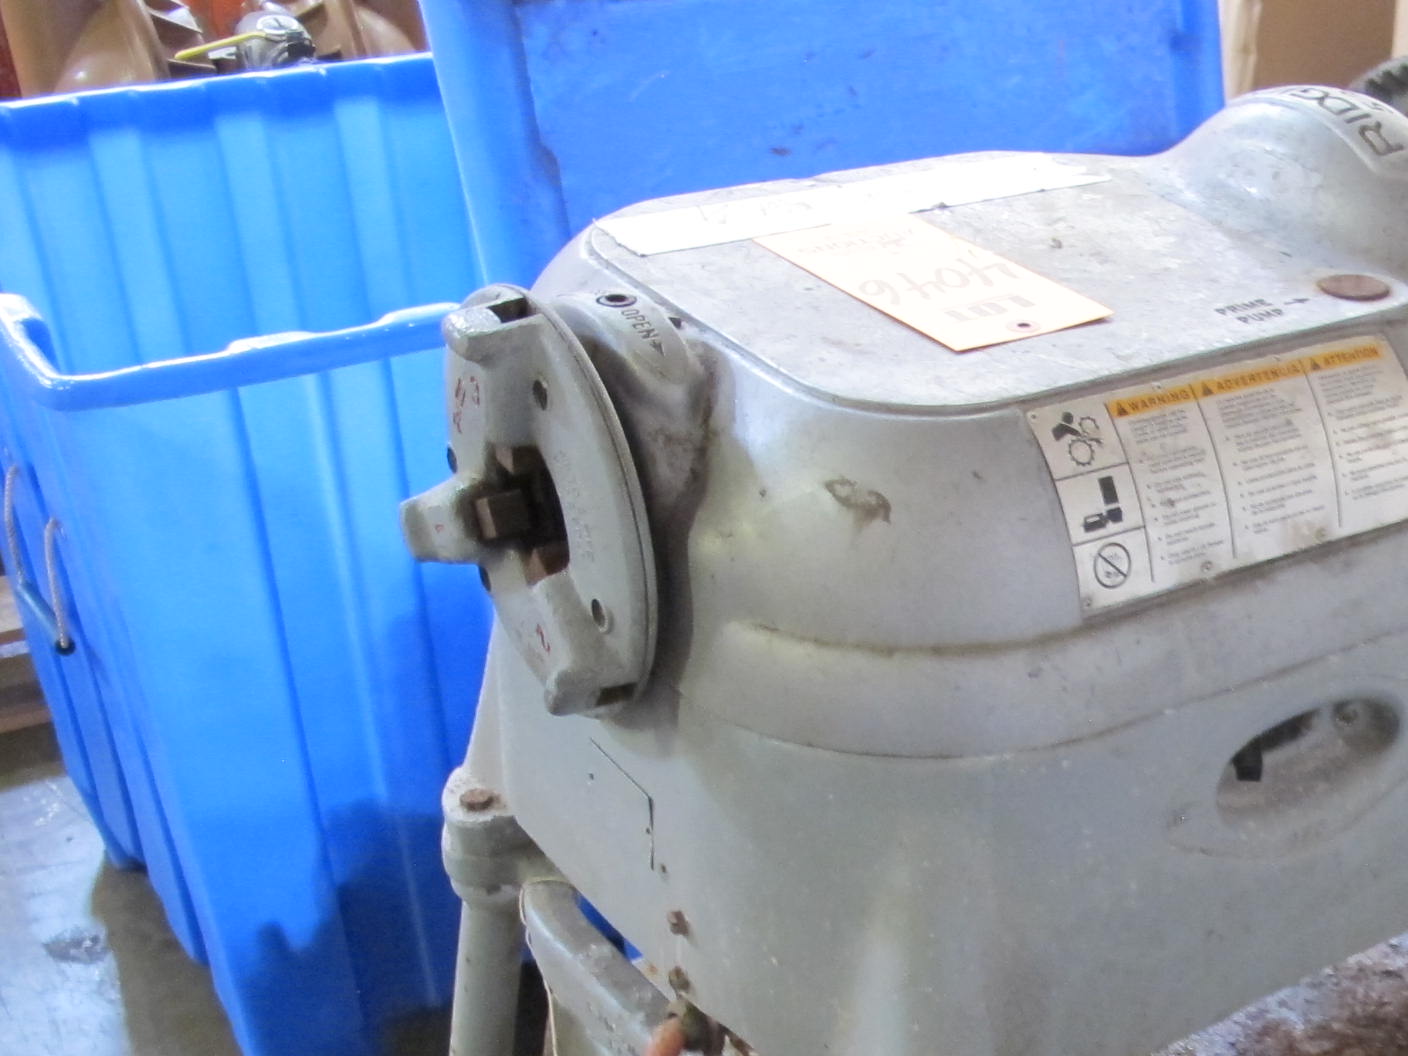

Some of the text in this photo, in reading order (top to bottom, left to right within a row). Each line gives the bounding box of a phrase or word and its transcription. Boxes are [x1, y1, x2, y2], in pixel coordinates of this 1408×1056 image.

[857, 258, 1020, 306] 4046
[1214, 299, 1273, 317] PRIME
[1236, 308, 1283, 325] PUMP
[621, 309, 659, 339] OPEN
[1127, 389, 1189, 412] WARNING
